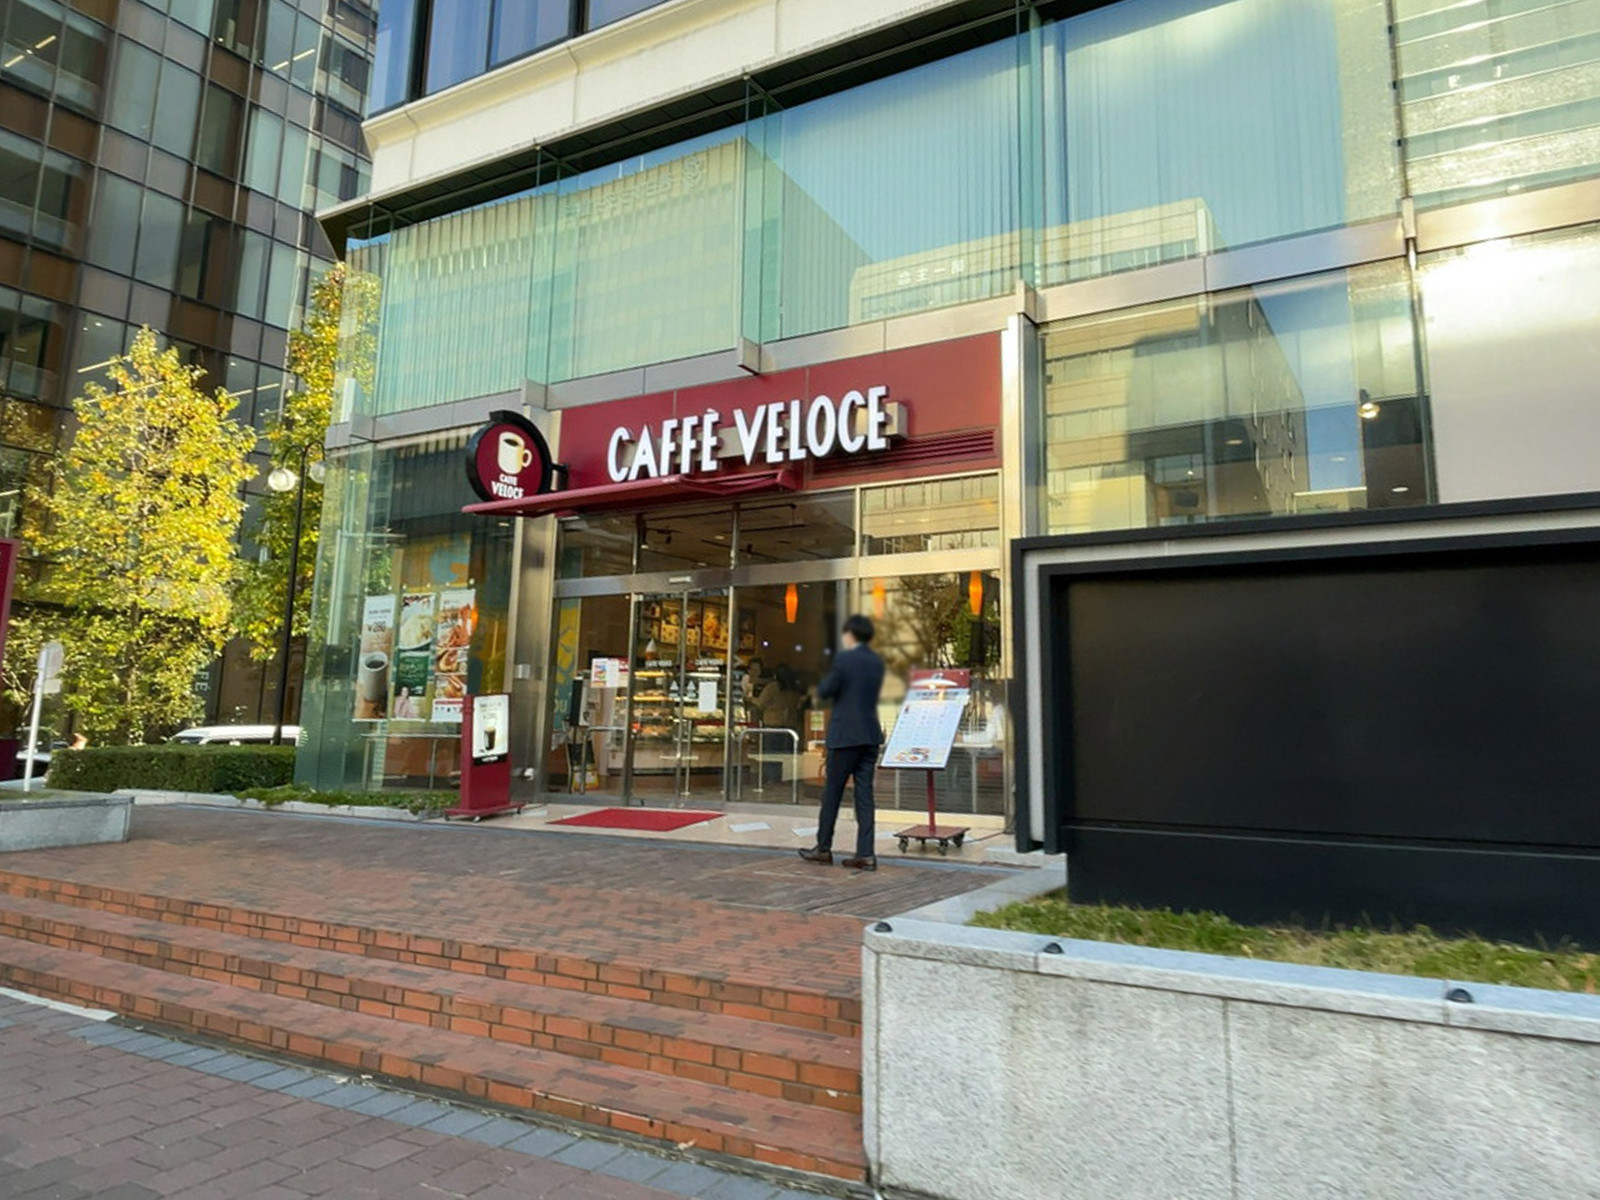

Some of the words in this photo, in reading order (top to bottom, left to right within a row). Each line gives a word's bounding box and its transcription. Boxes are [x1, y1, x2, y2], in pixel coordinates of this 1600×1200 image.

[607, 408, 720, 483] CAFFÈ
[733, 385, 887, 467] VELOCE
[491, 481, 524, 500] VELOCE
